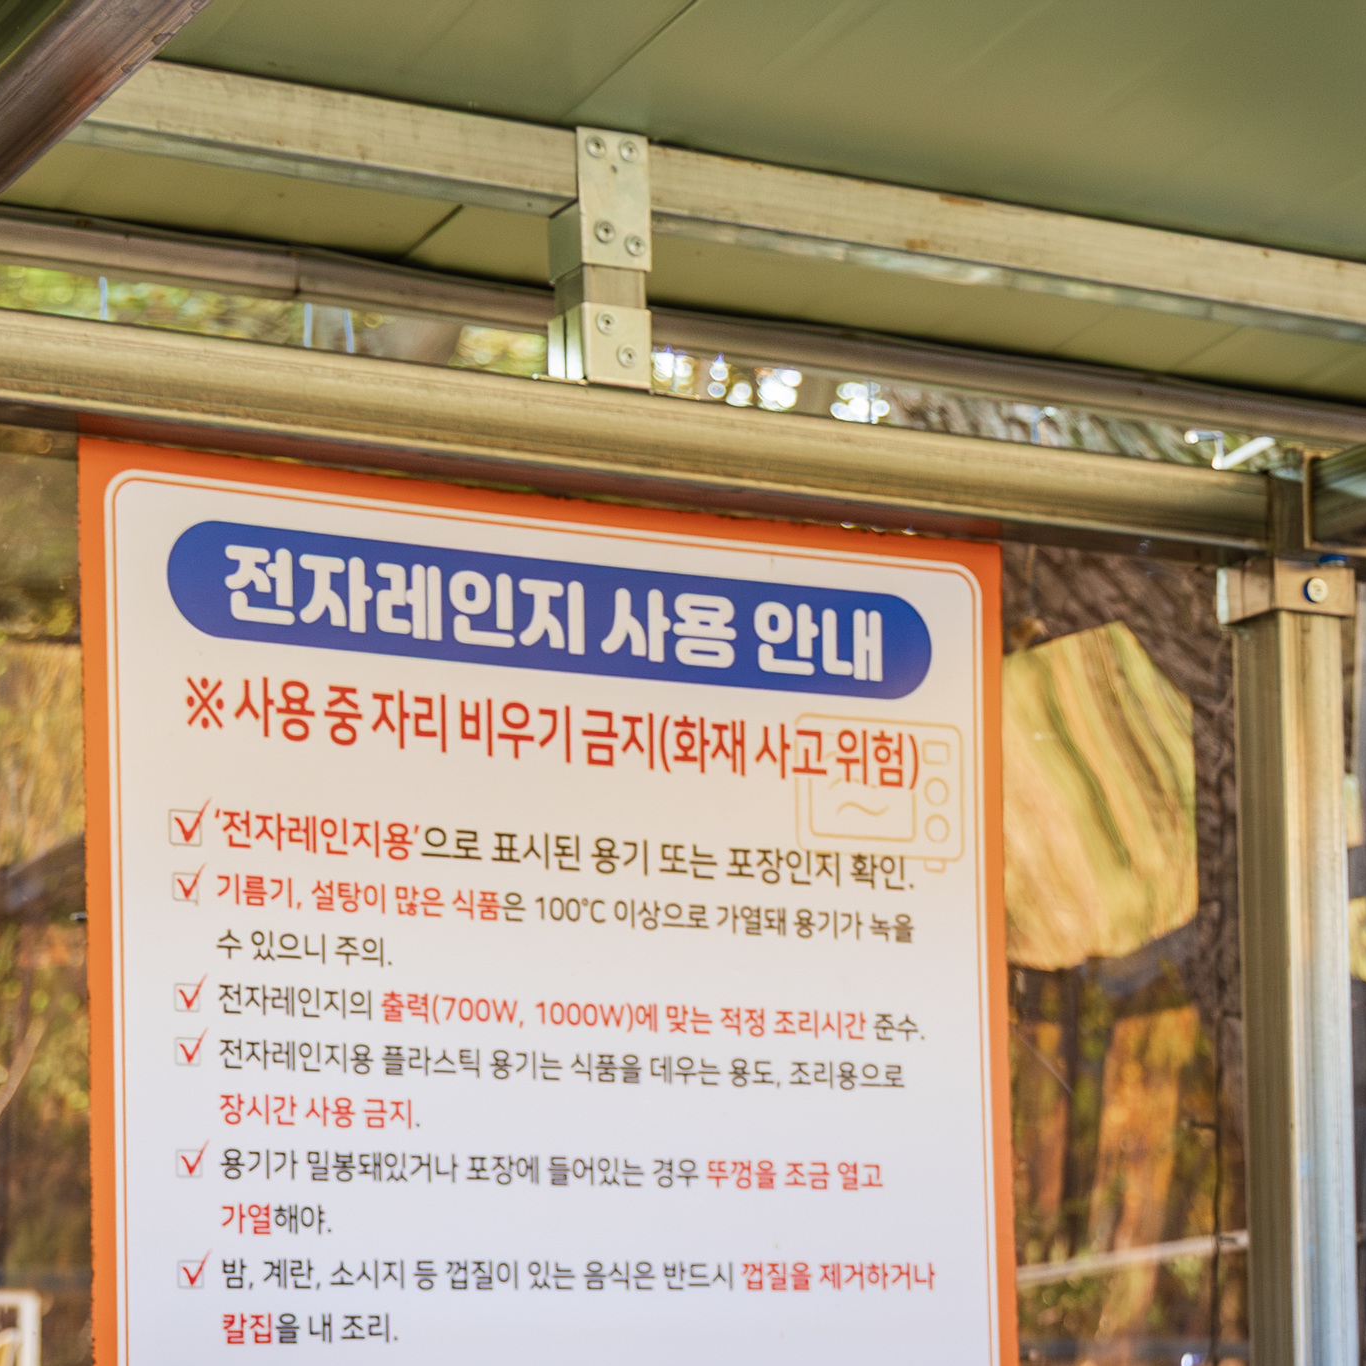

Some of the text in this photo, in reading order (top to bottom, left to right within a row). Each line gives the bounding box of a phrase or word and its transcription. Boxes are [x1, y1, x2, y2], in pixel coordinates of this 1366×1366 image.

[224, 543, 884, 683] 전자레인지 사용 안내
[323, 684, 364, 747] 중
[370, 688, 448, 754] 자리
[459, 697, 572, 765] 비우기
[580, 708, 746, 777] 금지(화재
[754, 715, 832, 780] 사고
[833, 717, 923, 791] 위험)
[490, 831, 581, 873] 표시된
[590, 836, 649, 877] 용기
[658, 842, 719, 881] 또는
[725, 847, 841, 888] 포장인지
[849, 851, 920, 892] 확인.
[216, 872, 303, 910] 기름기,
[311, 879, 386, 915] 설탕이
[394, 885, 446, 918] 많은
[451, 889, 527, 923] 식품은
[613, 898, 710, 932] 이상으로
[716, 904, 787, 937] 가열돼
[792, 907, 864, 941] 용기가
[868, 912, 916, 944] 녹을
[215, 928, 393, 968] 수 있으니 주의.
[218, 983, 926, 1042] 전자레인지의 출력(700W, 1000W)에 맞는 적정 조리시간 준수.
[219, 1038, 906, 1091] 전자레인지용 플라스틱 용기는 식품을 데우는 용도, 조리용으로
[219, 1093, 421, 1130] 장시간 사용 금지.
[220, 1148, 884, 1191] 용기가 밀봉돼있거나 포장에 들어있는 경우 뚜껑을 조금 열고
[221, 1203, 332, 1235] 가열해야.
[222, 1258, 936, 1292] 밤, 계란, 소시지 등 껍질이 있는 음식은 반드시 껍질을 제거하거나
[222, 1312, 398, 1345] 칼집을 내 조리.
